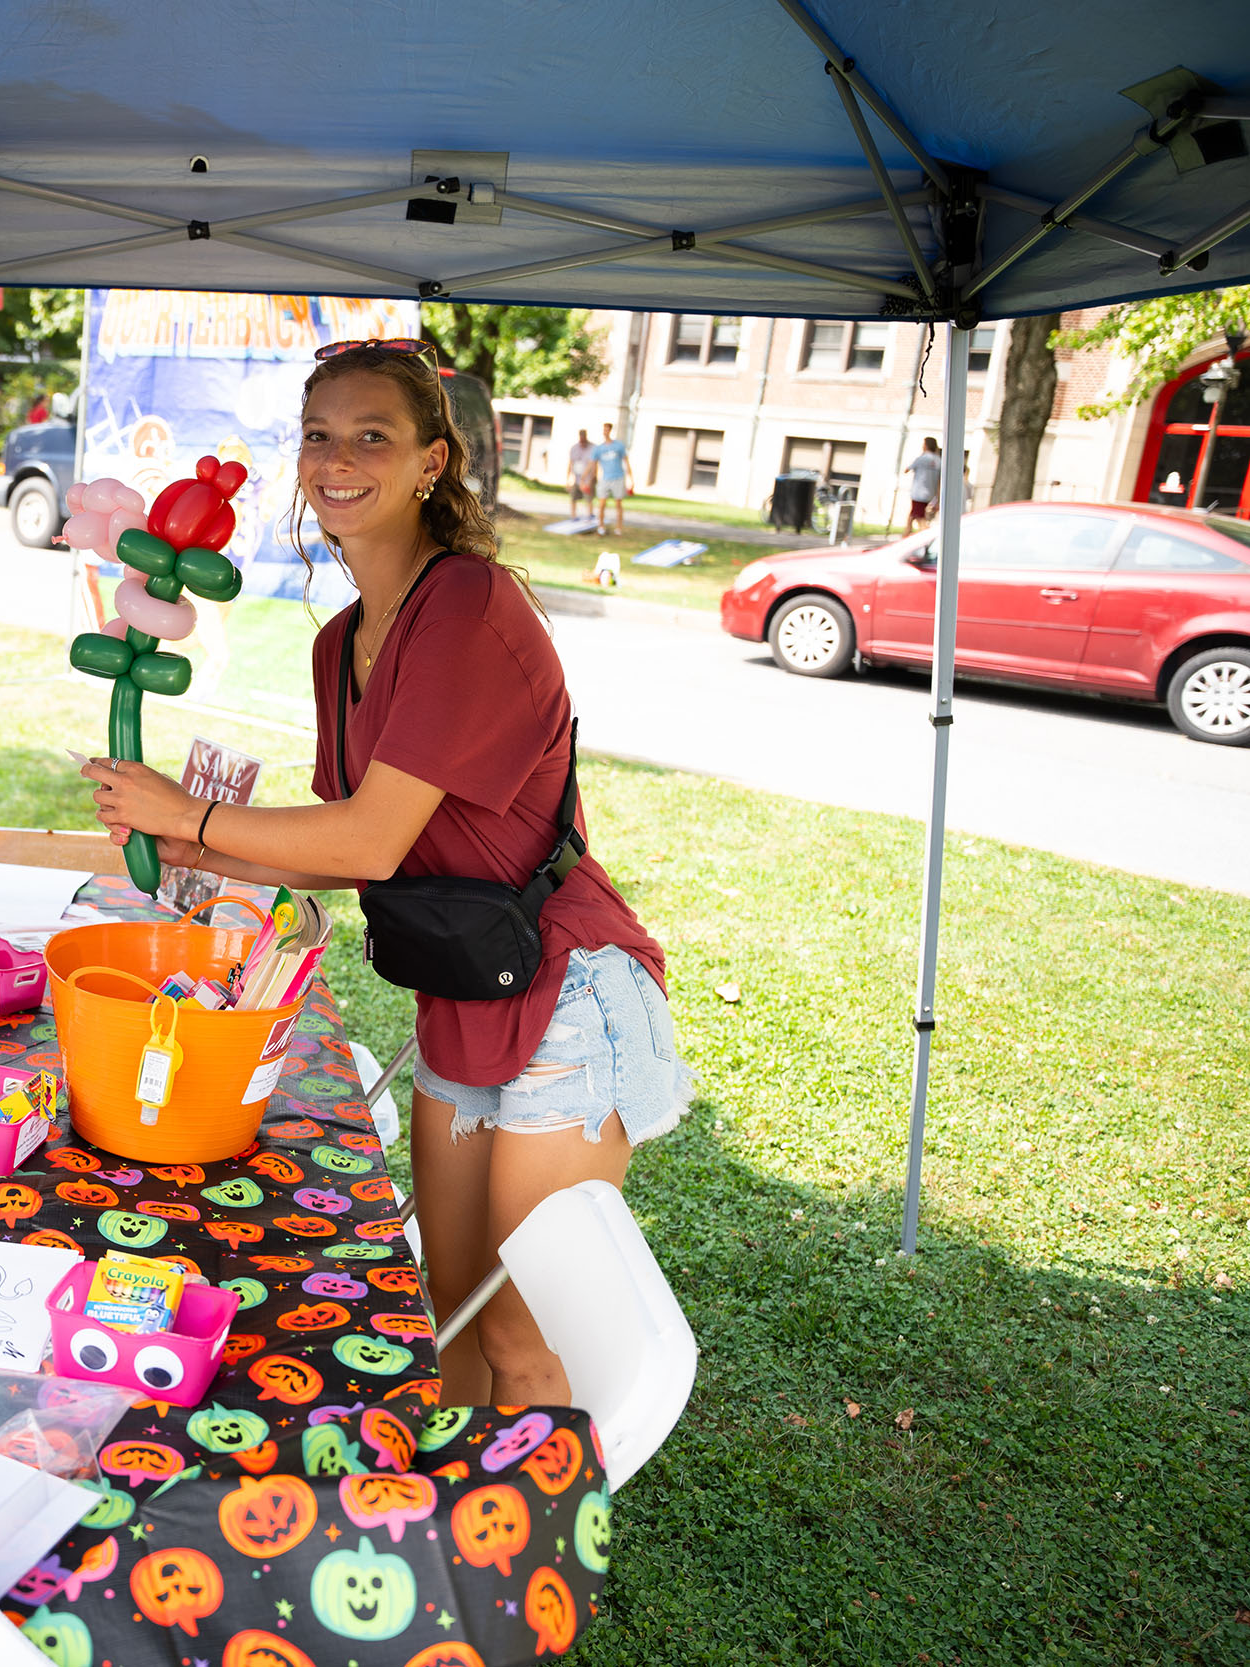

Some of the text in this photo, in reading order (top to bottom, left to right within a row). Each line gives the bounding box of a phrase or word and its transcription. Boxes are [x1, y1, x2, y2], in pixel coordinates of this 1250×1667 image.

[198, 749, 246, 789] SAVE
[190, 773, 239, 804] DATE
[108, 1267, 164, 1287] Crayola
[87, 1309, 142, 1322] BLUETIFUL
